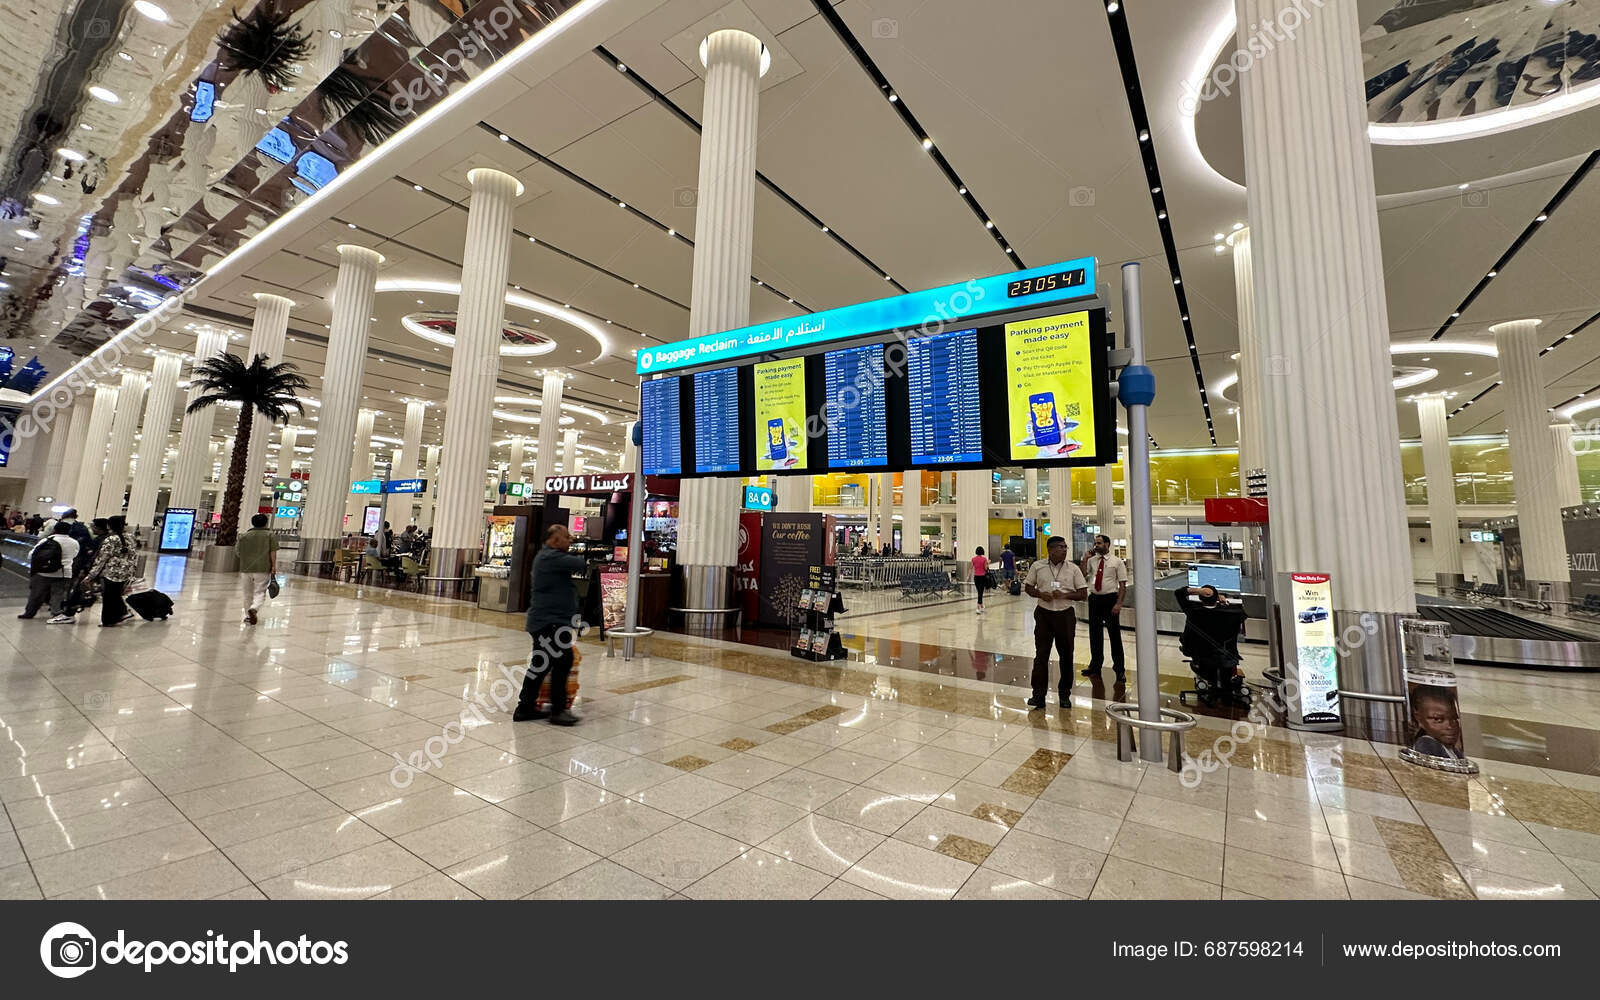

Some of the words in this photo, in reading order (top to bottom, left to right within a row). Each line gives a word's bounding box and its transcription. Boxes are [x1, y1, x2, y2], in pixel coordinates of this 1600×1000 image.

[785, 318, 825, 342] استلام
[1010, 327, 1042, 337] Parking
[1044, 320, 1084, 333] payment
[1023, 334, 1048, 344] made
[1049, 332, 1070, 340] easy
[655, 347, 697, 363] Baggage
[698, 337, 738, 354] Reclaim
[757, 367, 777, 375] Parking
[777, 363, 802, 373] payment
[545, 476, 585, 492] COSTA
[590, 474, 630, 492] كوستا
[748, 492, 759, 503] 8A
[781, 522, 796, 530] DON'T
[787, 530, 810, 541] coffee
[1569, 553, 1598, 572] AZIZI
[736, 578, 759, 590] STA
